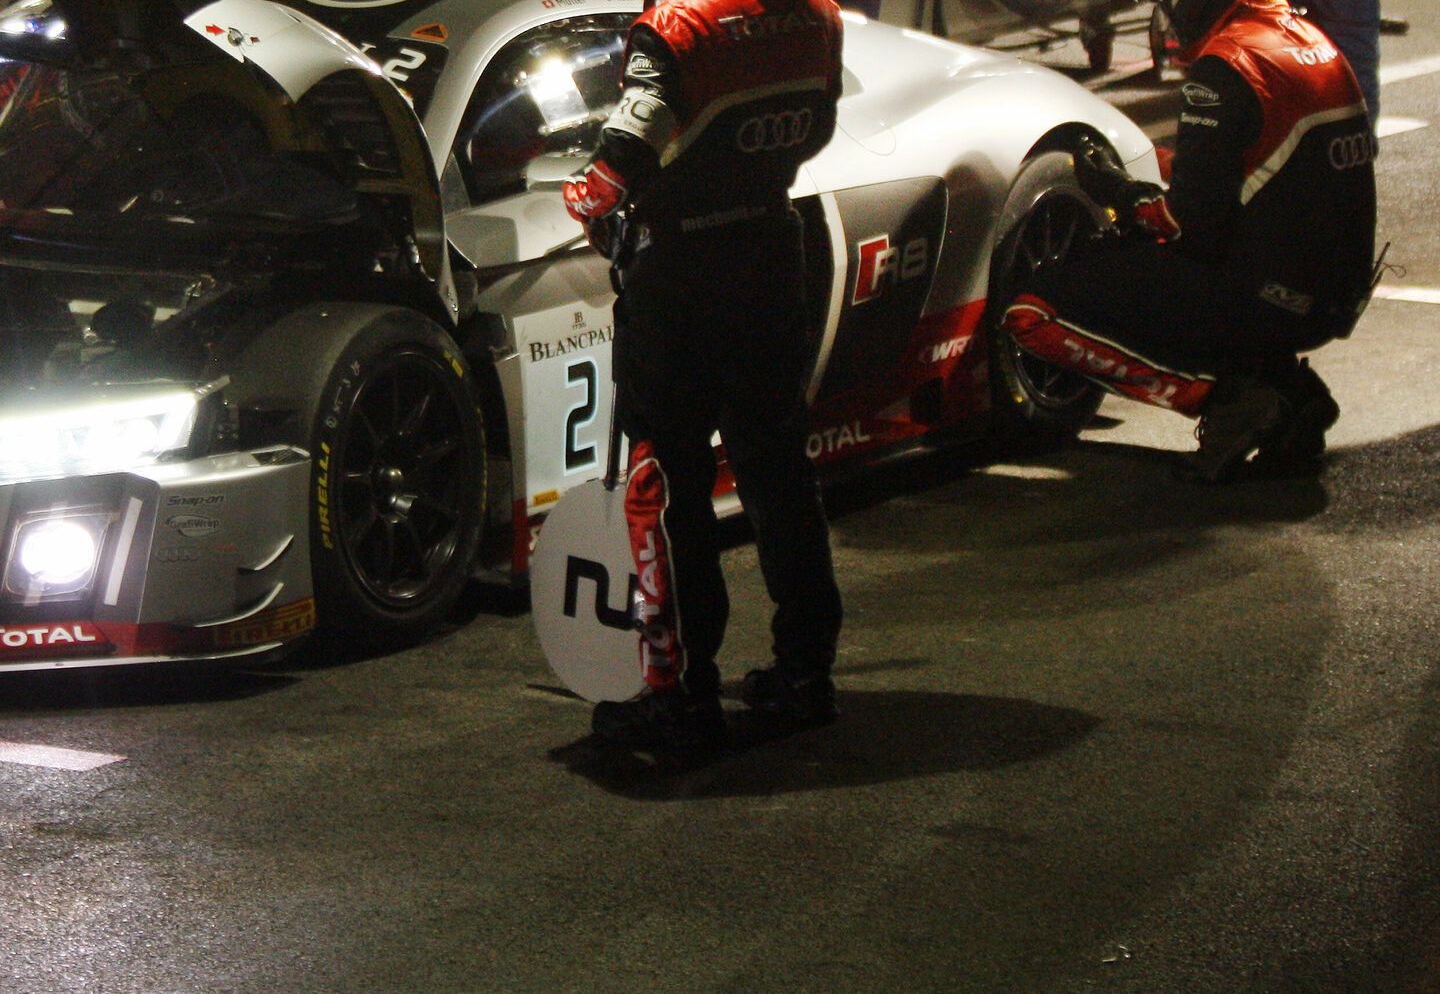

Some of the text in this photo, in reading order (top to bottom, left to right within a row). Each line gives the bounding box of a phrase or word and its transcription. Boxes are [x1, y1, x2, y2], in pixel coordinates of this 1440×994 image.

[382, 48, 427, 83] 2
[1282, 46, 1339, 66] TOTA
[529, 324, 615, 363] BLANCPAI
[564, 357, 598, 471] 2
[805, 420, 871, 459] OTAL
[167, 494, 225, 507] Snap-on
[317, 441, 335, 551] PIRELLI
[638, 530, 672, 679] TOTAL
